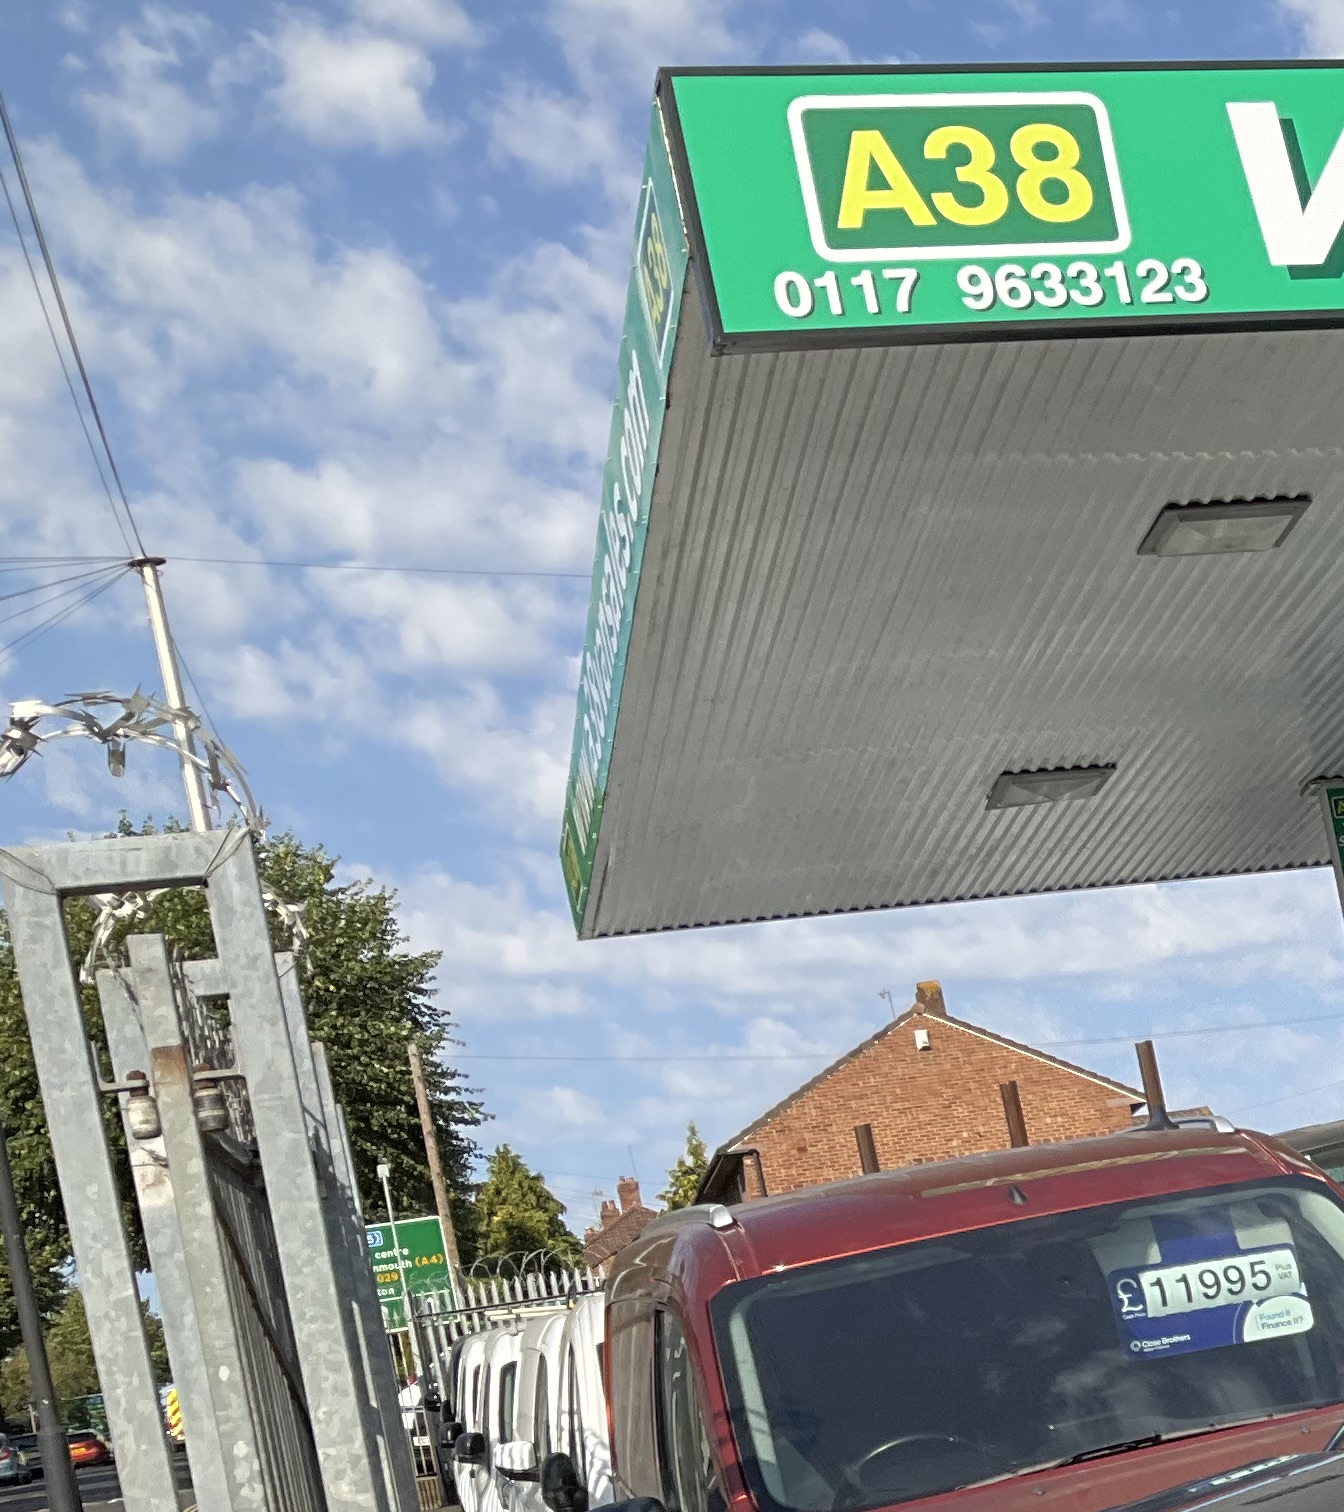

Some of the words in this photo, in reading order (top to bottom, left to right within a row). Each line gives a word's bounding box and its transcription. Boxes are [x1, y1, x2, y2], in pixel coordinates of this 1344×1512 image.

[836, 124, 1095, 230] A38
[774, 267, 922, 318] 0117
[960, 257, 1211, 312] 9633123
[415, 1253, 444, 1268] (A4)
[1260, 1311, 1284, 1321] Found
[1261, 1319, 1292, 1330] Finance
